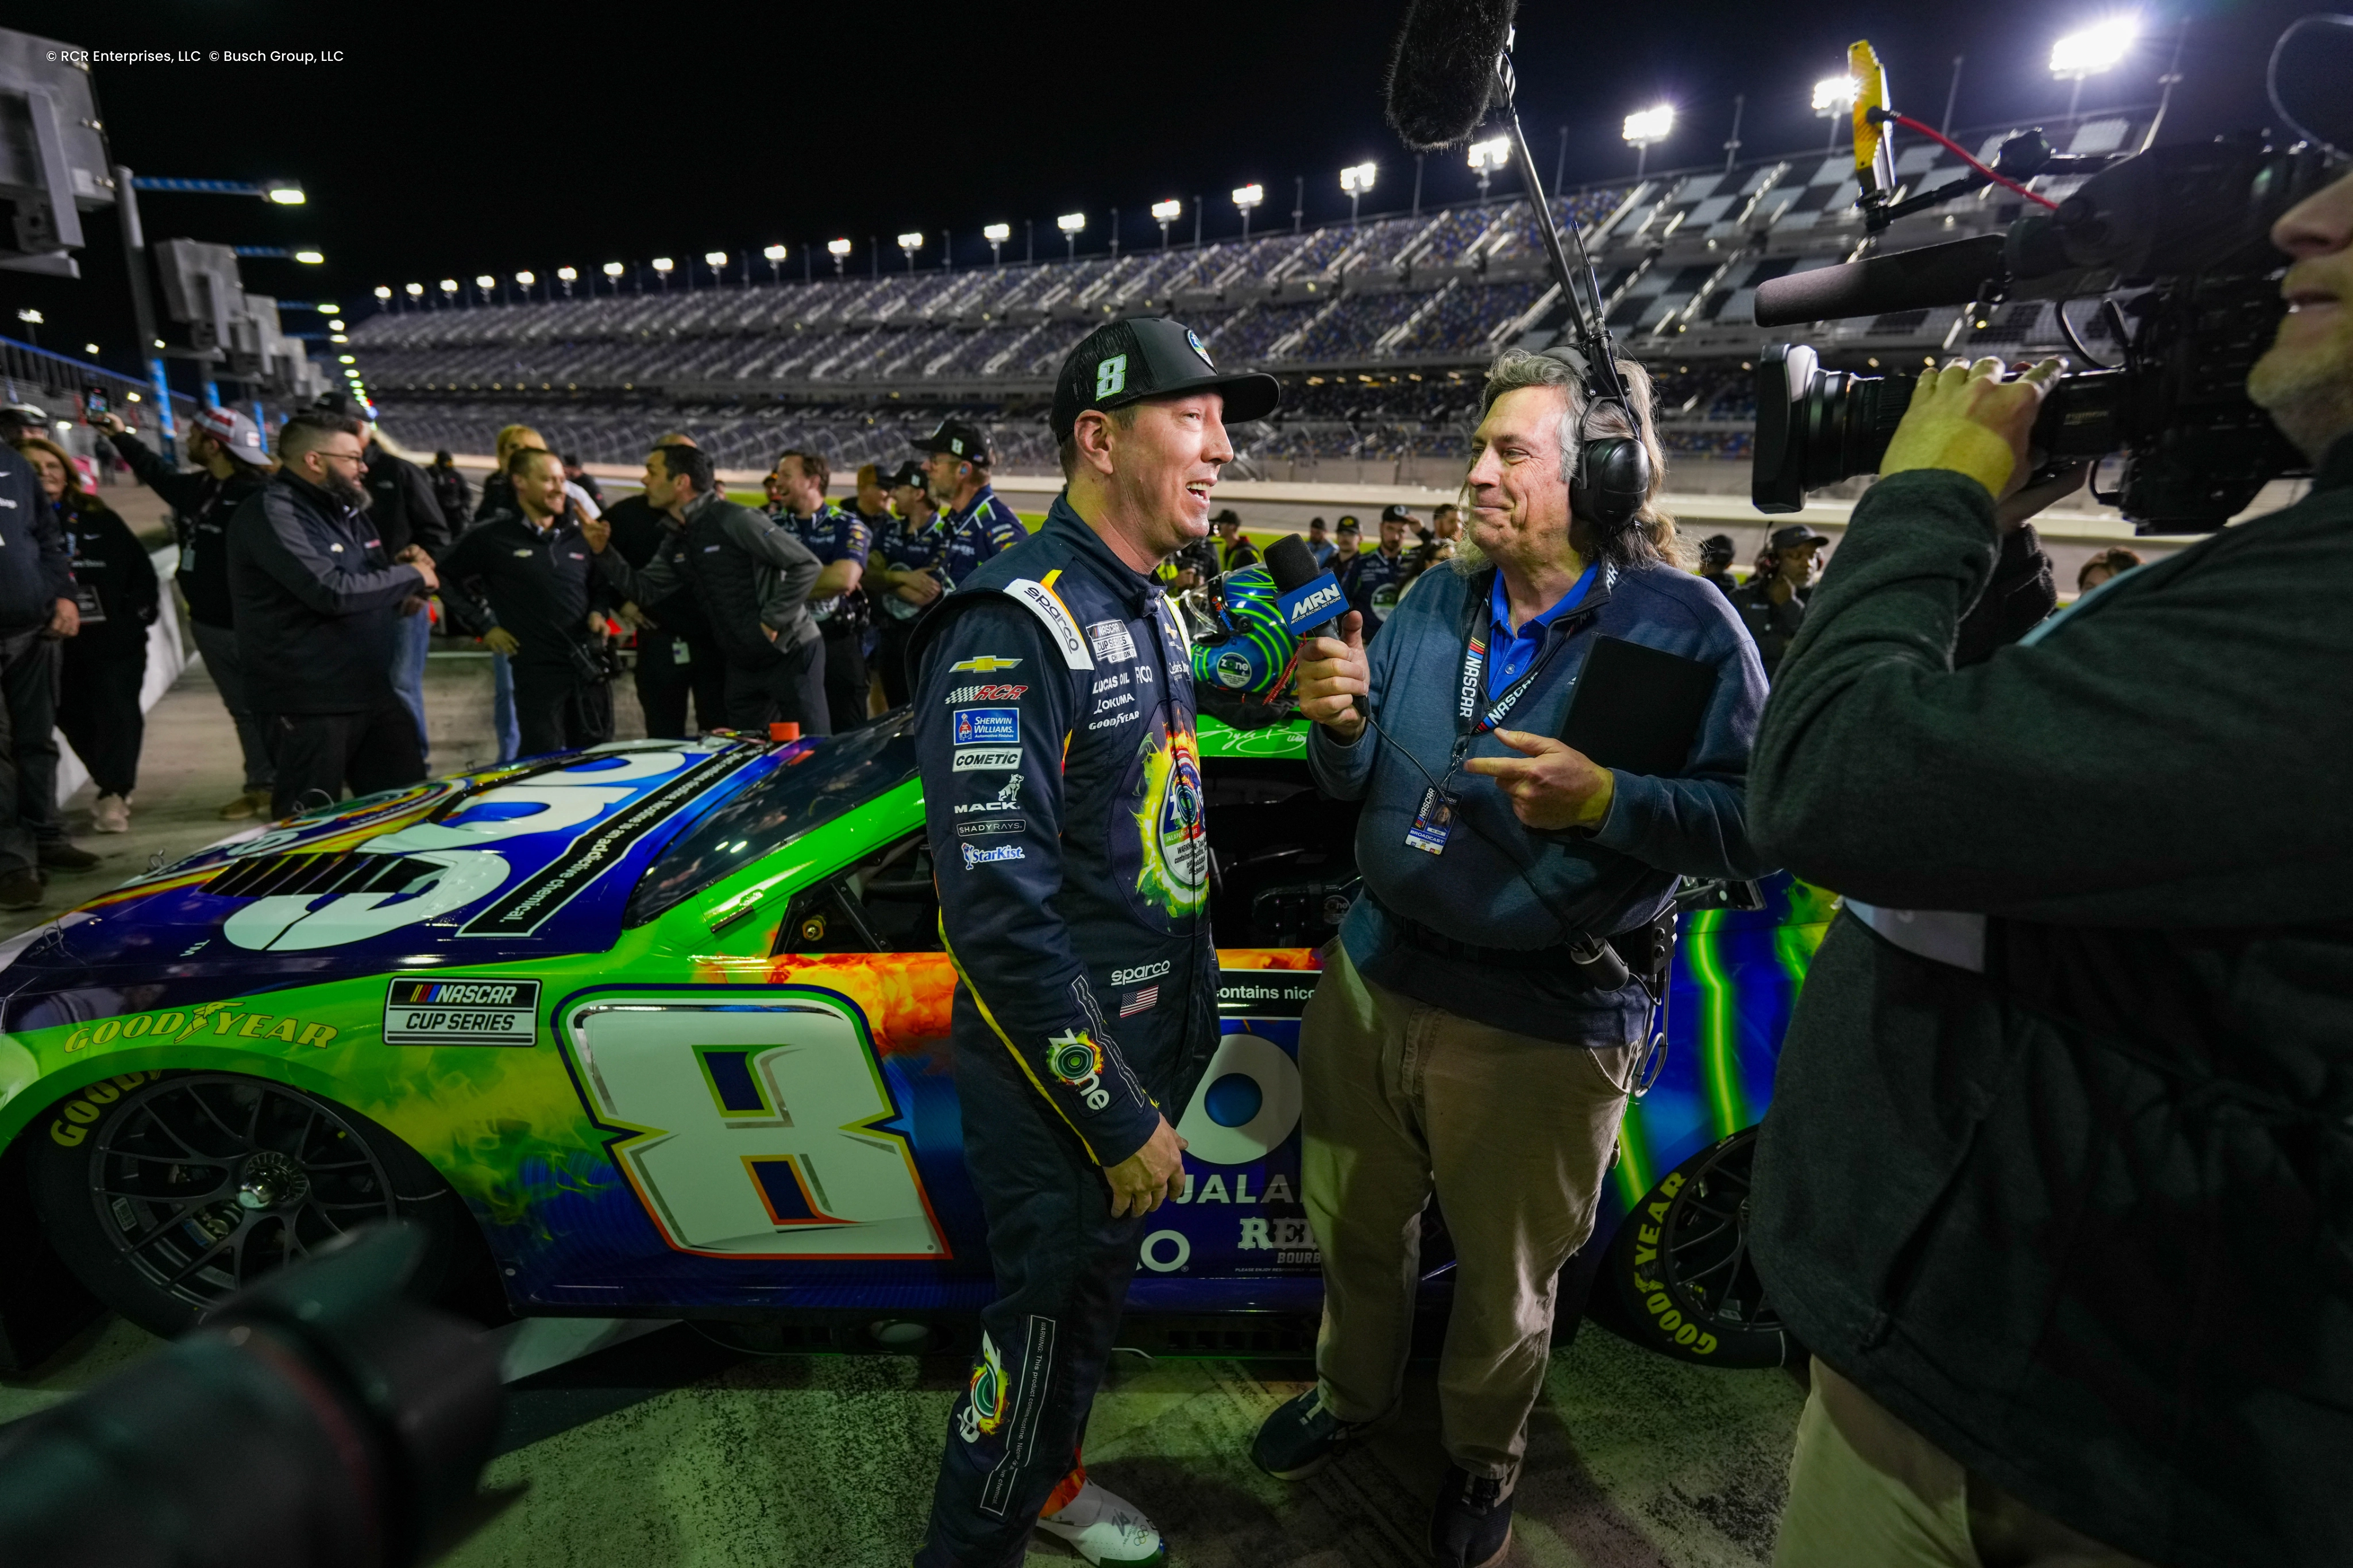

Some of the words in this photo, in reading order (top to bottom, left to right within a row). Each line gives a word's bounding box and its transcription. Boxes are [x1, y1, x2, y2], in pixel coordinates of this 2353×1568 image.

[1096, 354, 1127, 401] 8
[1291, 583, 1340, 620] MRN
[1291, 614, 1306, 624] MOTOR
[1306, 607, 1321, 616] RACING
[1322, 596, 1342, 608] NETWORK
[1024, 587, 1079, 654] sparco
[1098, 623, 1120, 636] NASCAR
[1097, 640, 1108, 651] CUP
[1109, 636, 1127, 647] SERIES
[1093, 676, 1118, 694] LUCAS
[1120, 673, 1129, 685] OIL
[1135, 666, 1153, 684] FICO
[973, 685, 1028, 700] RCR
[1460, 656, 1482, 718] NASCAR
[1094, 693, 1135, 715] LOKUMA
[975, 716, 1012, 725] SHERWIN
[1089, 710, 1139, 730] GOODYEAR
[956, 754, 1018, 767] COMETIC
[954, 802, 1017, 814] MACK
[1419, 787, 1435, 819] NASCAR
[1410, 830, 1444, 844] BROADCAST
[973, 845, 1023, 862] StarKist
[499, 879, 565, 922] chemical.
[1111, 960, 1170, 986] sparco
[438, 985, 517, 1004] NASCAR
[64, 1002, 338, 1053] GOODYEAR
[406, 1014, 443, 1030] CUP
[446, 1014, 515, 1031] SERIES
[556, 989, 951, 1258] 8
[1176, 1174, 1303, 1204] JALA
[1634, 1172, 1718, 1355] GOODYEAR
[1037, 1322, 1047, 1353] WARNING:
[1035, 1355, 1043, 1370] This
[1030, 1372, 1038, 1397] product
[1025, 1398, 1033, 1417] contains
[1018, 1418, 1027, 1440] nicotine.
[992, 1479, 1003, 1505] chemical.
